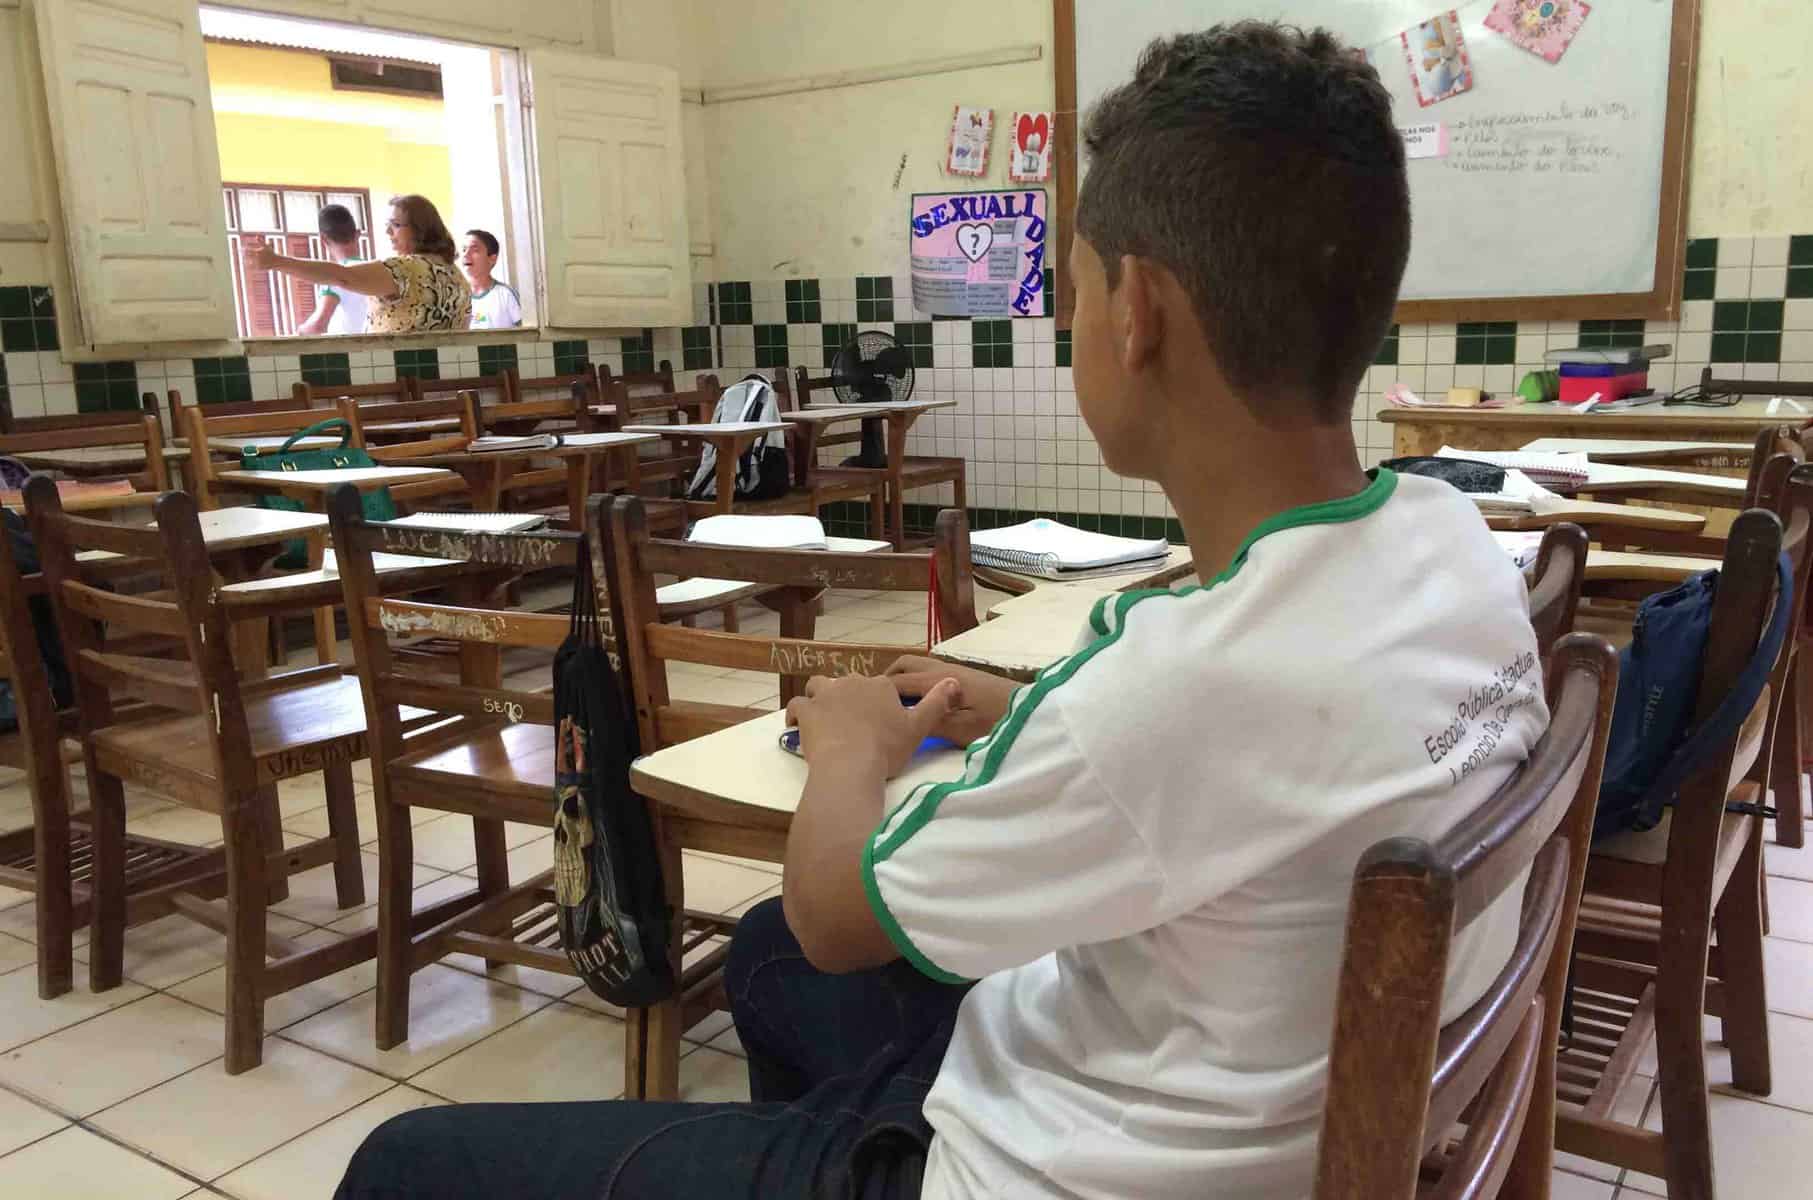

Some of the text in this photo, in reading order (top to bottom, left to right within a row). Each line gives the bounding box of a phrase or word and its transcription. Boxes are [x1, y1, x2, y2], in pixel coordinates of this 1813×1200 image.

[912, 193, 1046, 315] SEXUALIDADE
[1424, 717, 1466, 764] Escola
[1458, 686, 1503, 721] Pública
